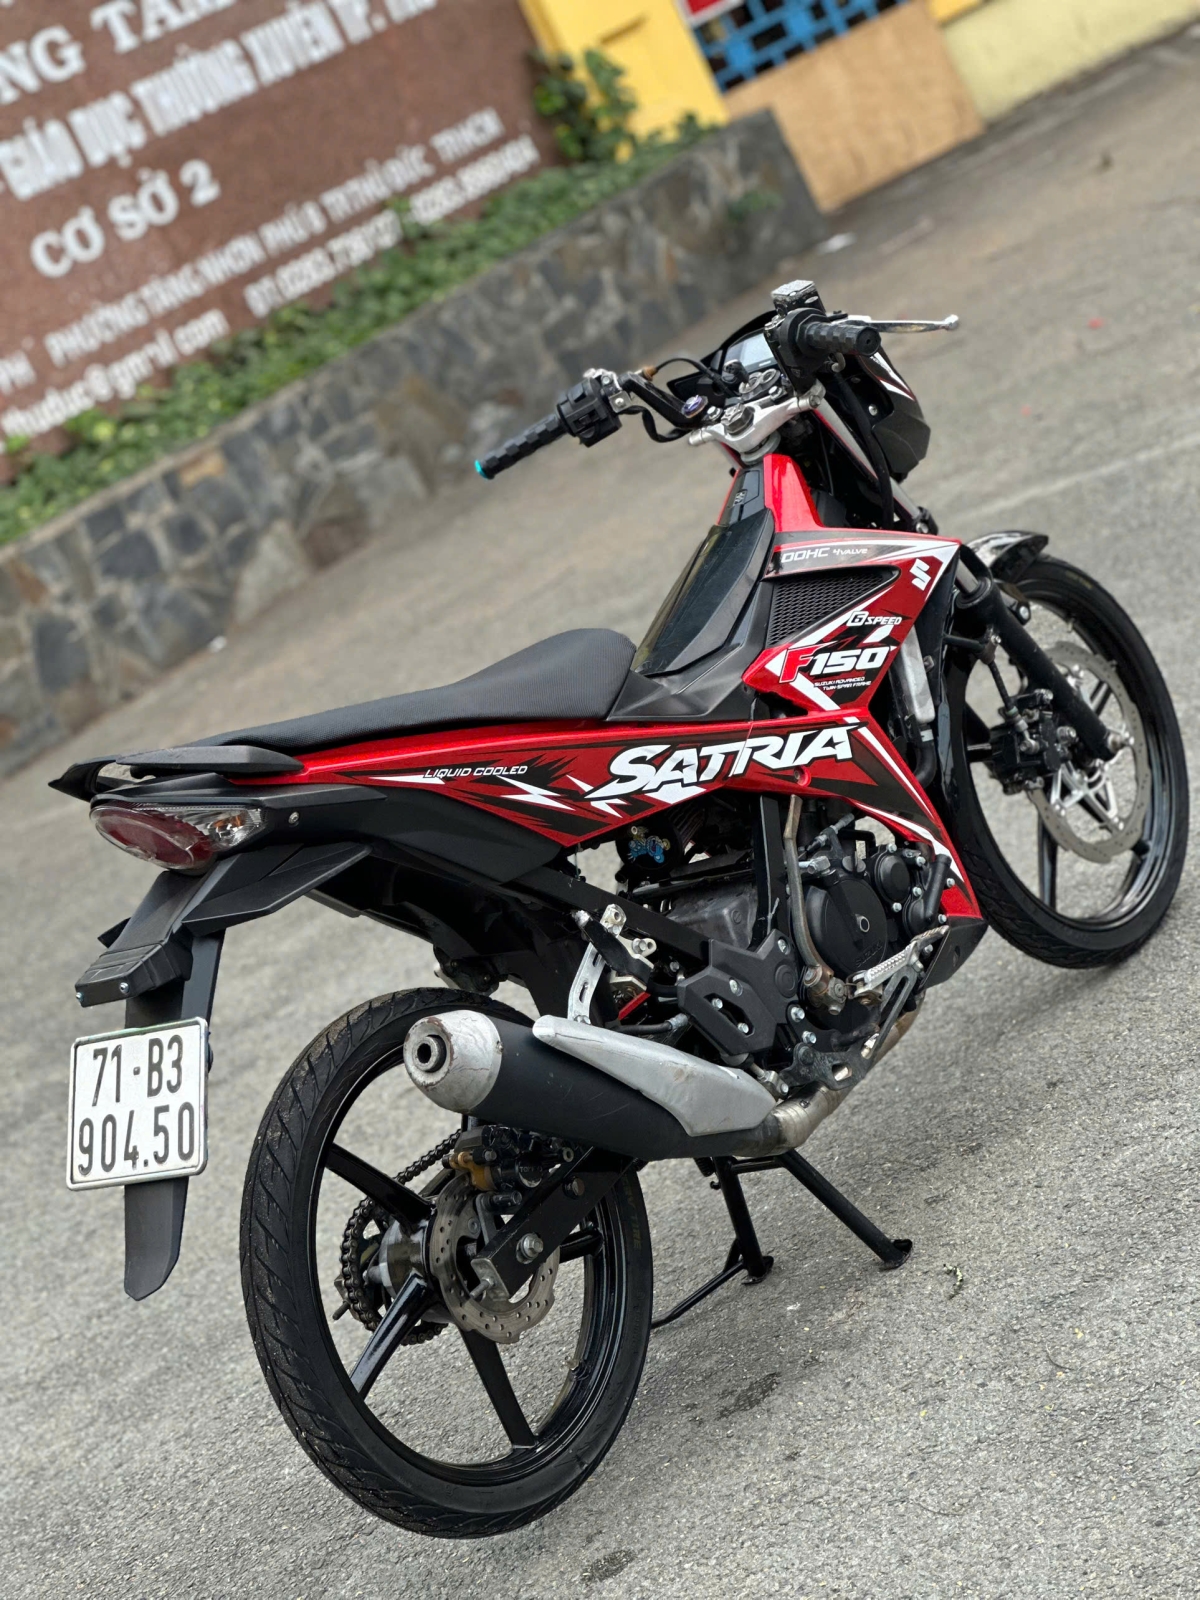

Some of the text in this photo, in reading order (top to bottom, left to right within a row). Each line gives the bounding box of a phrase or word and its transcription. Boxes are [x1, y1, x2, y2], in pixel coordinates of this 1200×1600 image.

[31, 159, 221, 278] CƠ SỞ 2
[781, 547, 830, 564] DOHC
[779, 641, 892, 683] F150
[423, 765, 529, 779] LIQUID COOLED
[584, 725, 862, 799] SATRIA
[78, 1102, 195, 1176] 904.50
